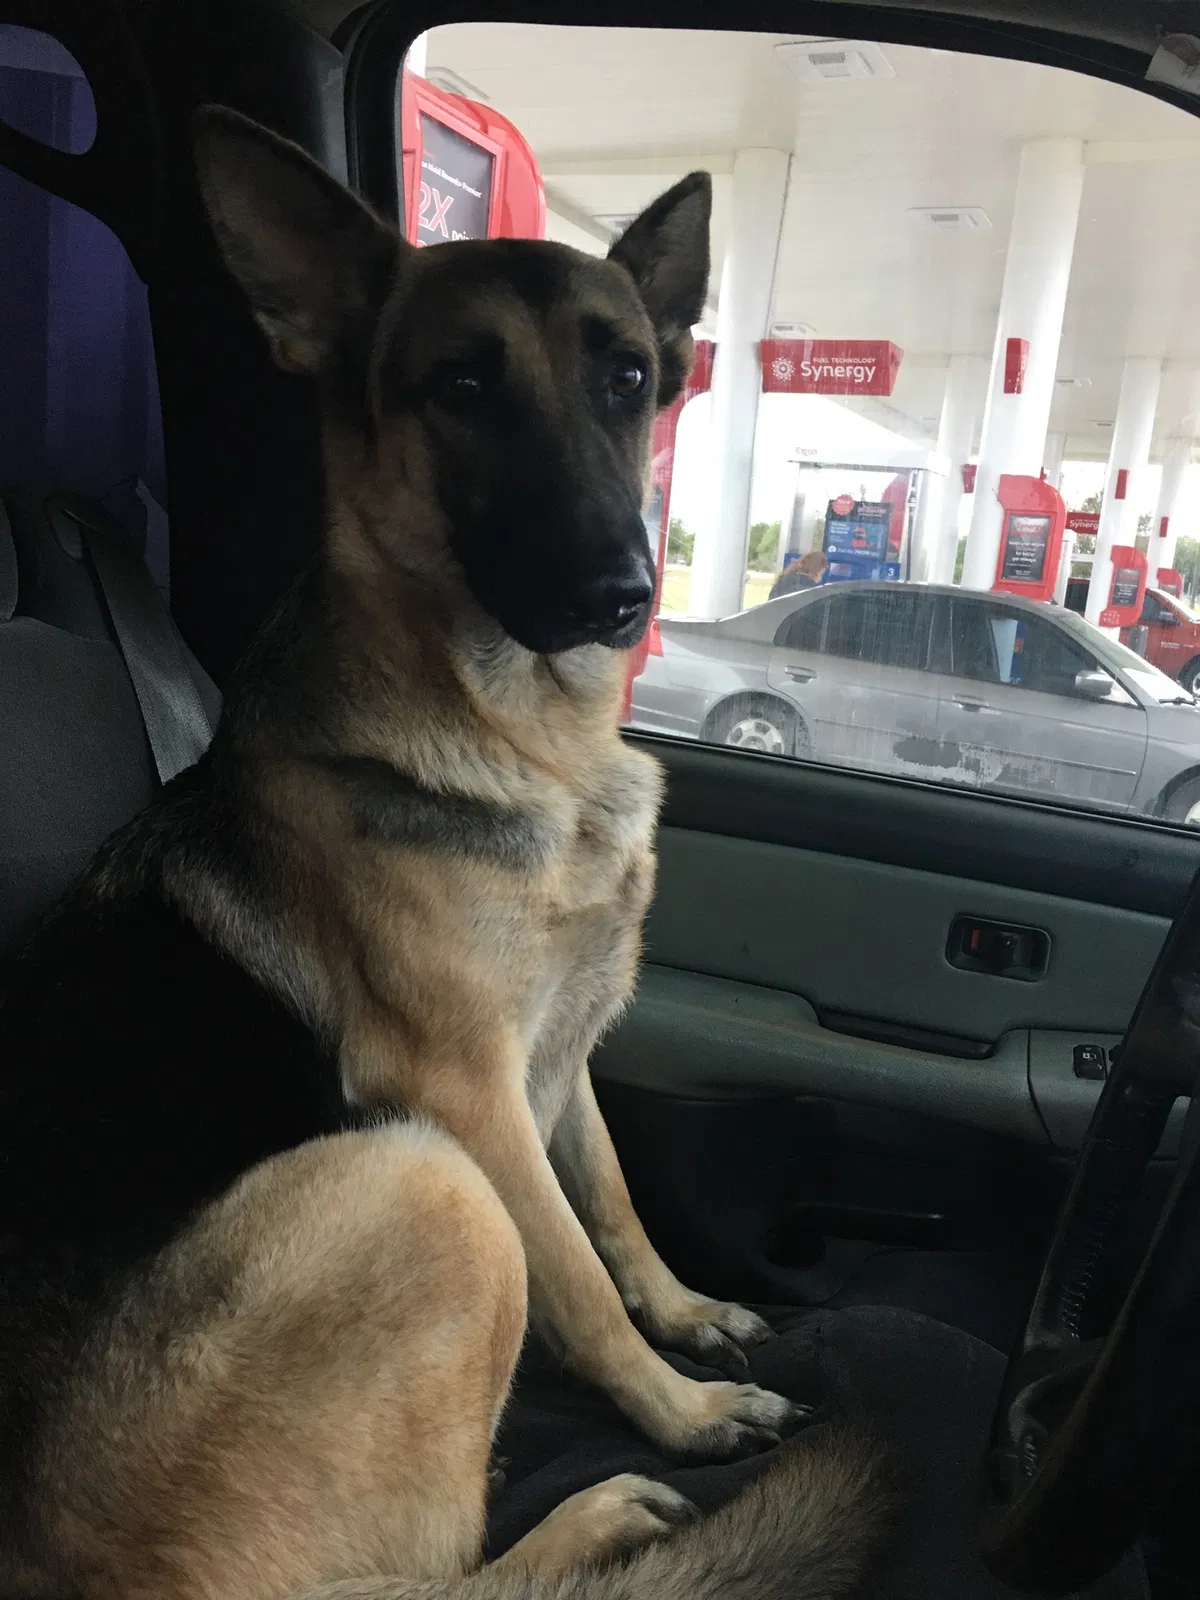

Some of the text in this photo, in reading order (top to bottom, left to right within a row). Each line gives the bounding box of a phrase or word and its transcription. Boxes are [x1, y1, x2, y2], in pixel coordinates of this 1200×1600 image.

[417, 181, 455, 239] 2X
[800, 361, 876, 382] Synergy
[796, 447, 817, 457] Exxon
[1069, 519, 1099, 530] Synerg
[888, 568, 895, 577] 3
